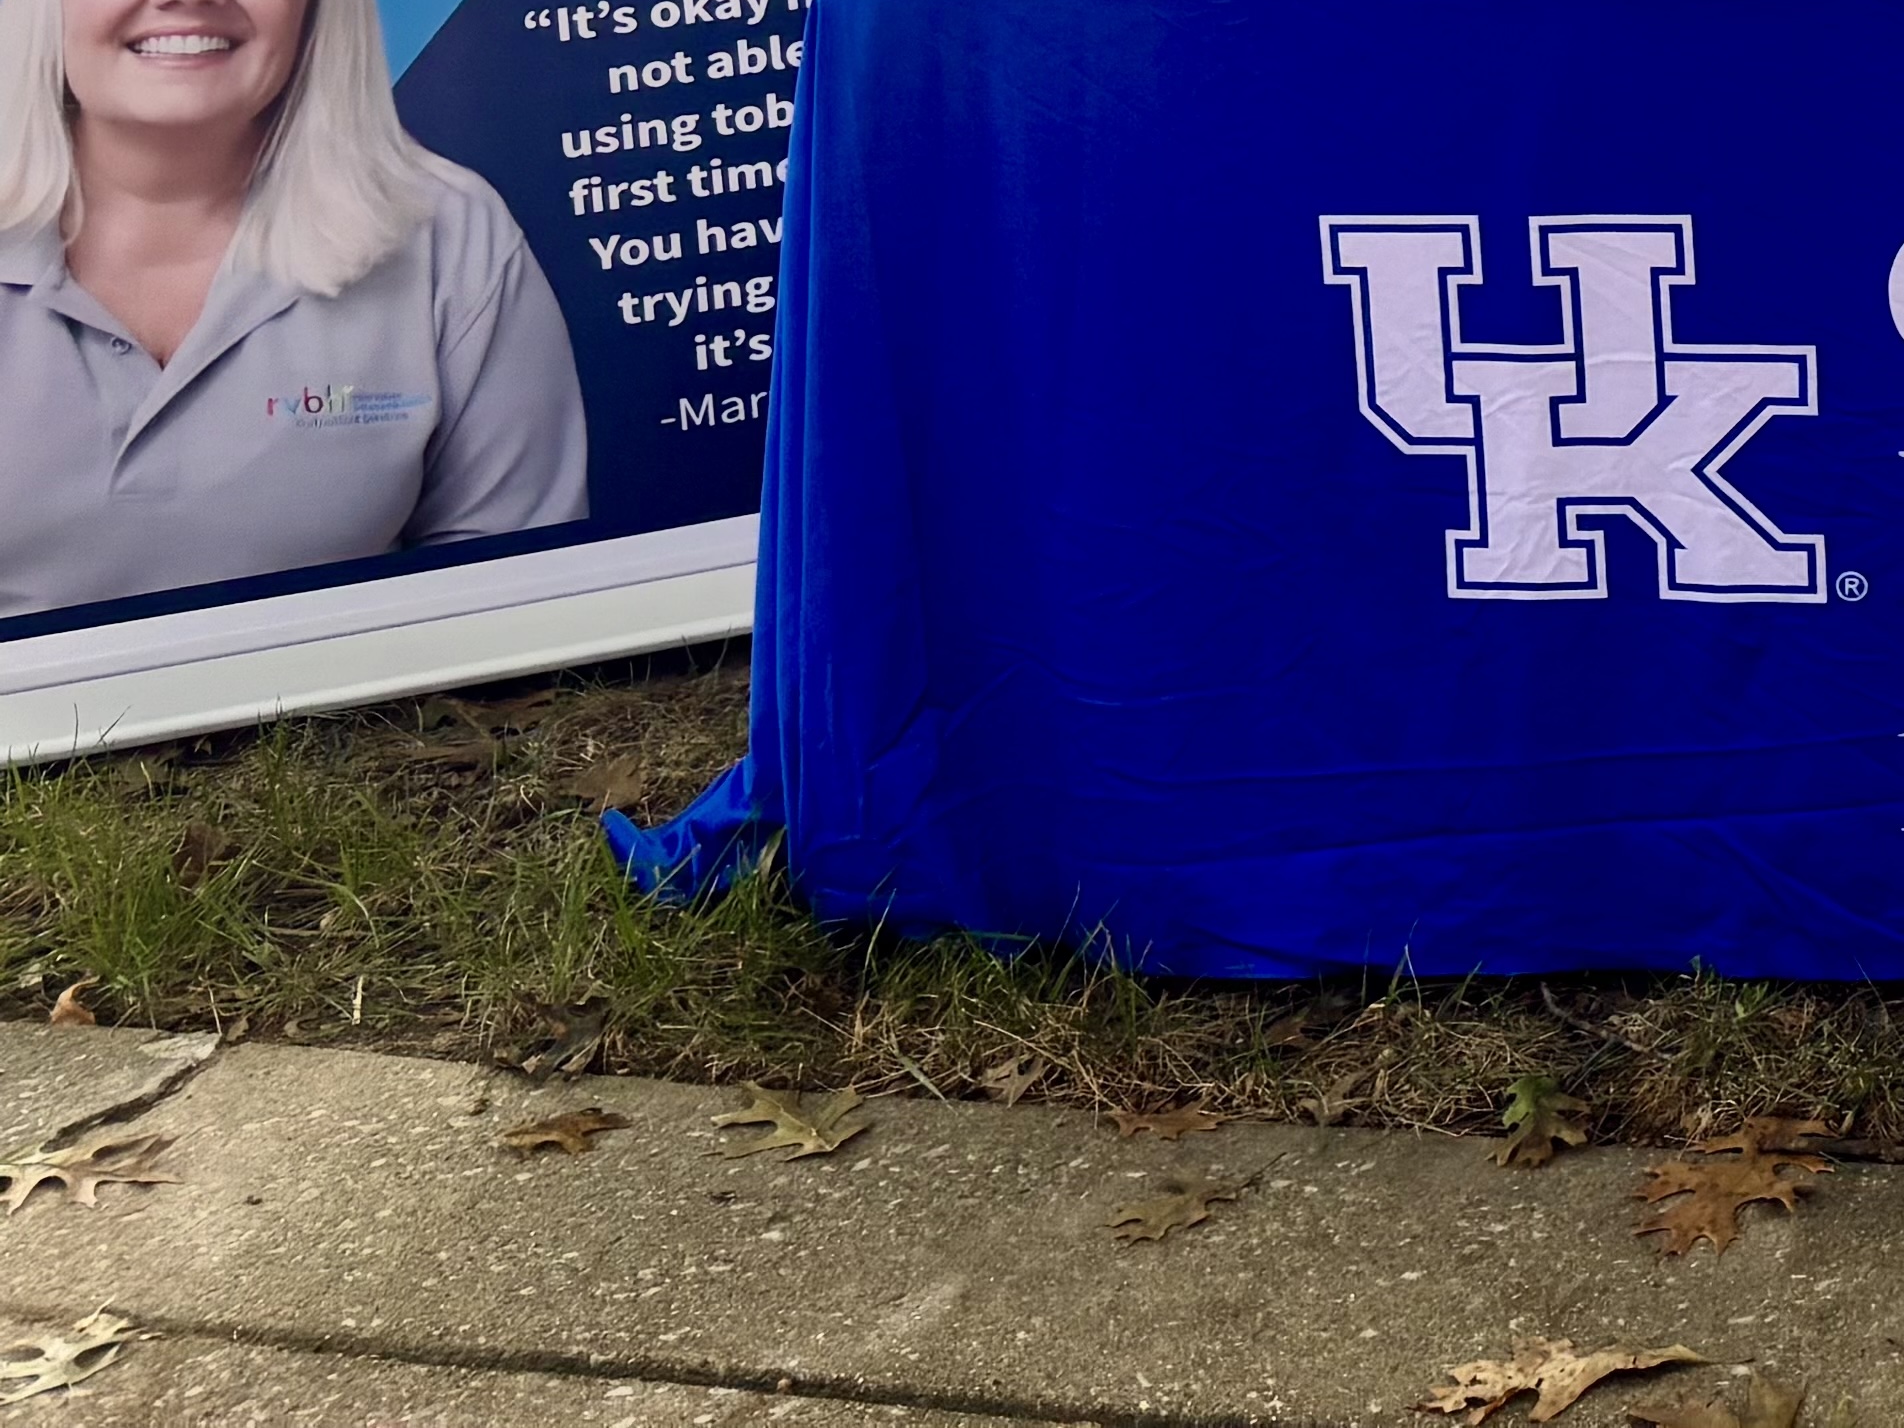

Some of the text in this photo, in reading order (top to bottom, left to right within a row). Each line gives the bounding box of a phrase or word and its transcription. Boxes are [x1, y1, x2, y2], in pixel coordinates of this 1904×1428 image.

[609, 50, 694, 94] not
[561, 111, 702, 158] using
[568, 173, 677, 216] first
[589, 230, 682, 270] You
[617, 274, 775, 327] trying
[1319, 212, 1829, 606] UK
